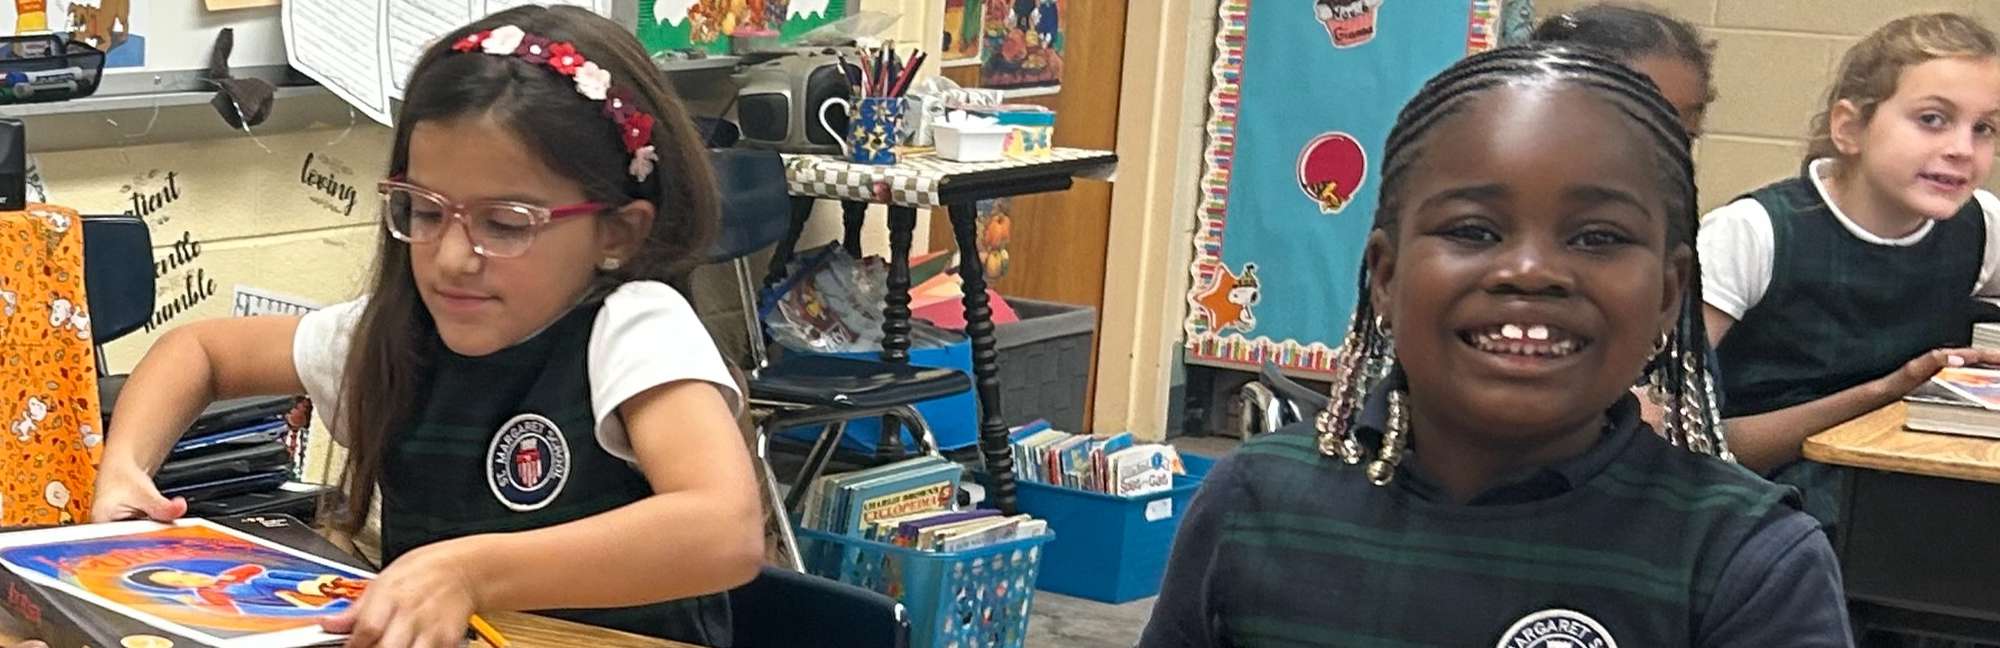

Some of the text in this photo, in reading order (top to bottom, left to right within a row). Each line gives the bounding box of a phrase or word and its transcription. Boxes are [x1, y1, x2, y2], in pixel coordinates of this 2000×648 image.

[124, 171, 181, 217] tient
[301, 152, 357, 217] loving
[495, 421, 546, 464] MARGARET
